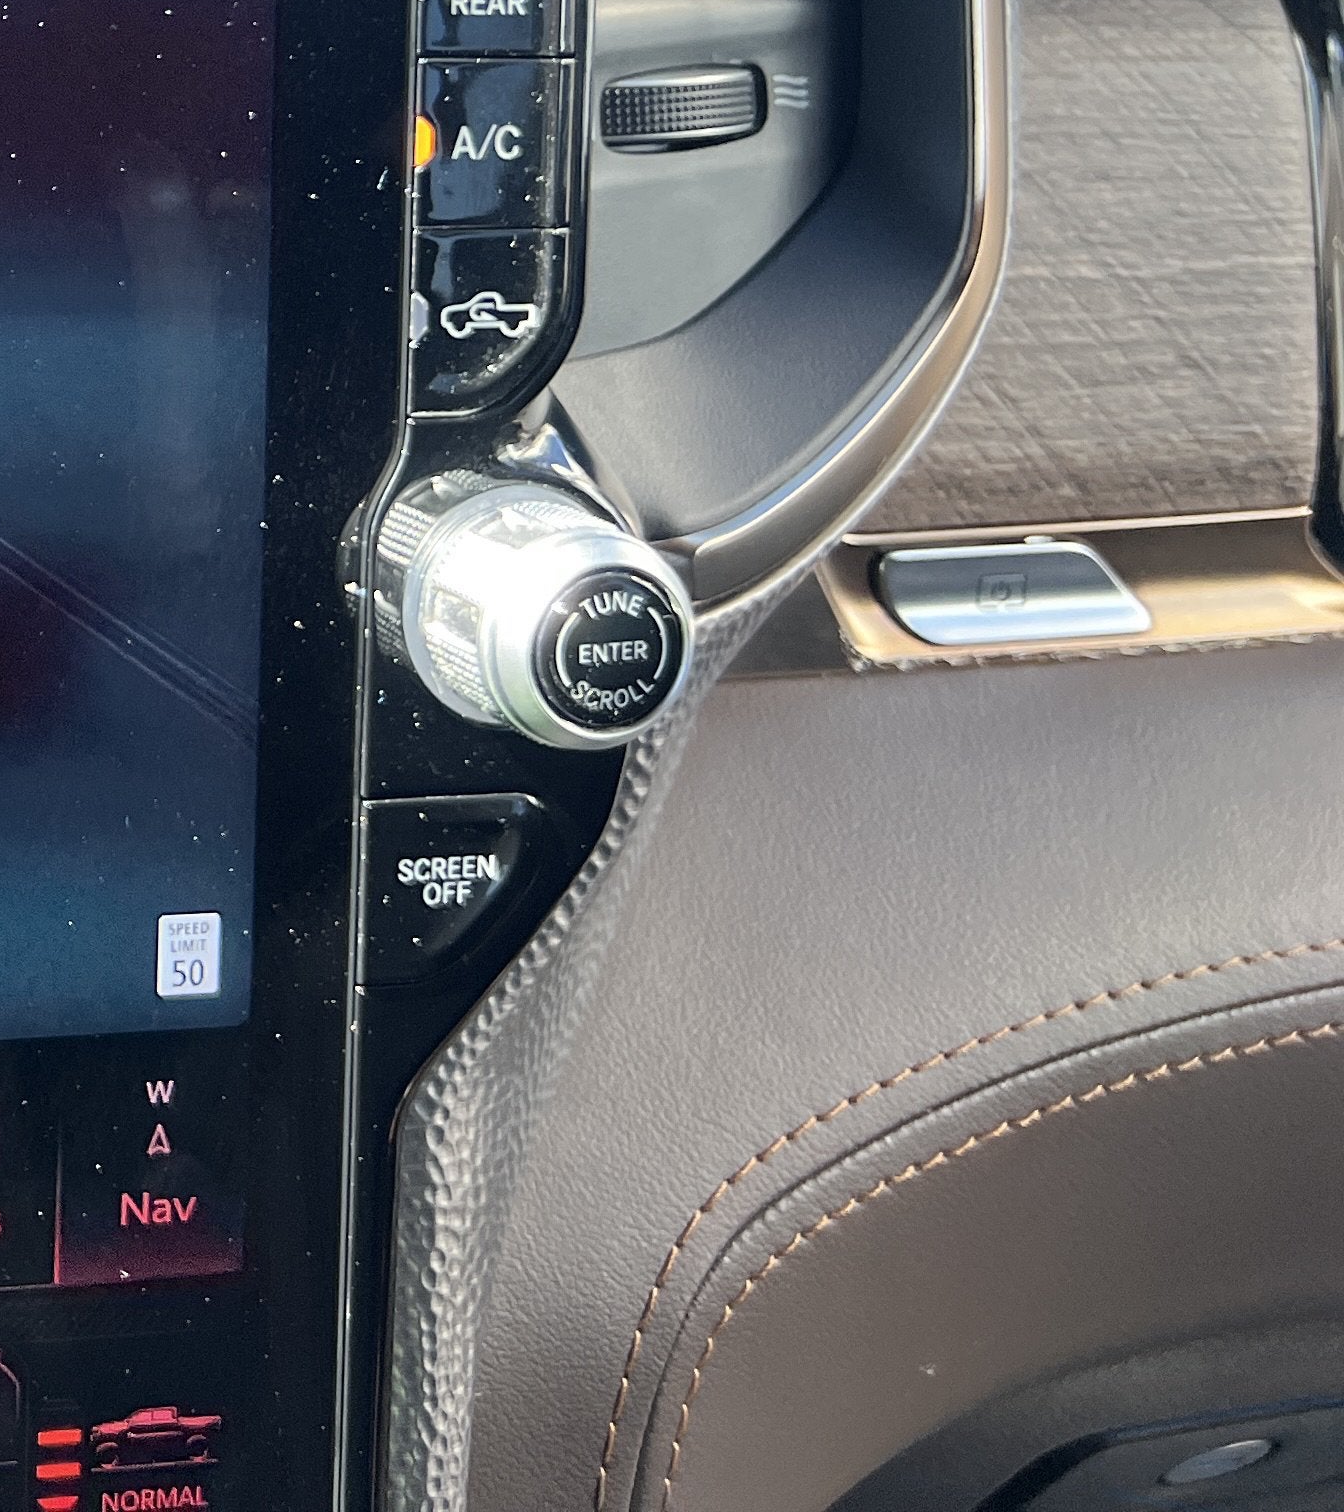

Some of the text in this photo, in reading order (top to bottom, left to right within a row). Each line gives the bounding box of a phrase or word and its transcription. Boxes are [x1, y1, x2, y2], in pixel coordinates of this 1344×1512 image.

[451, 124, 522, 160] A/C
[579, 591, 646, 621] TUNE
[578, 640, 648, 666] ENTER
[571, 678, 655, 710] SCROLL
[397, 854, 497, 884] SCREEN
[422, 880, 472, 908] OFF
[169, 922, 210, 935] SPEED
[170, 939, 208, 953] LIMIT
[172, 959, 204, 987] 50
[146, 1080, 174, 1105] W
[119, 1191, 198, 1227] Nav
[102, 1485, 208, 1512] NORMAL
